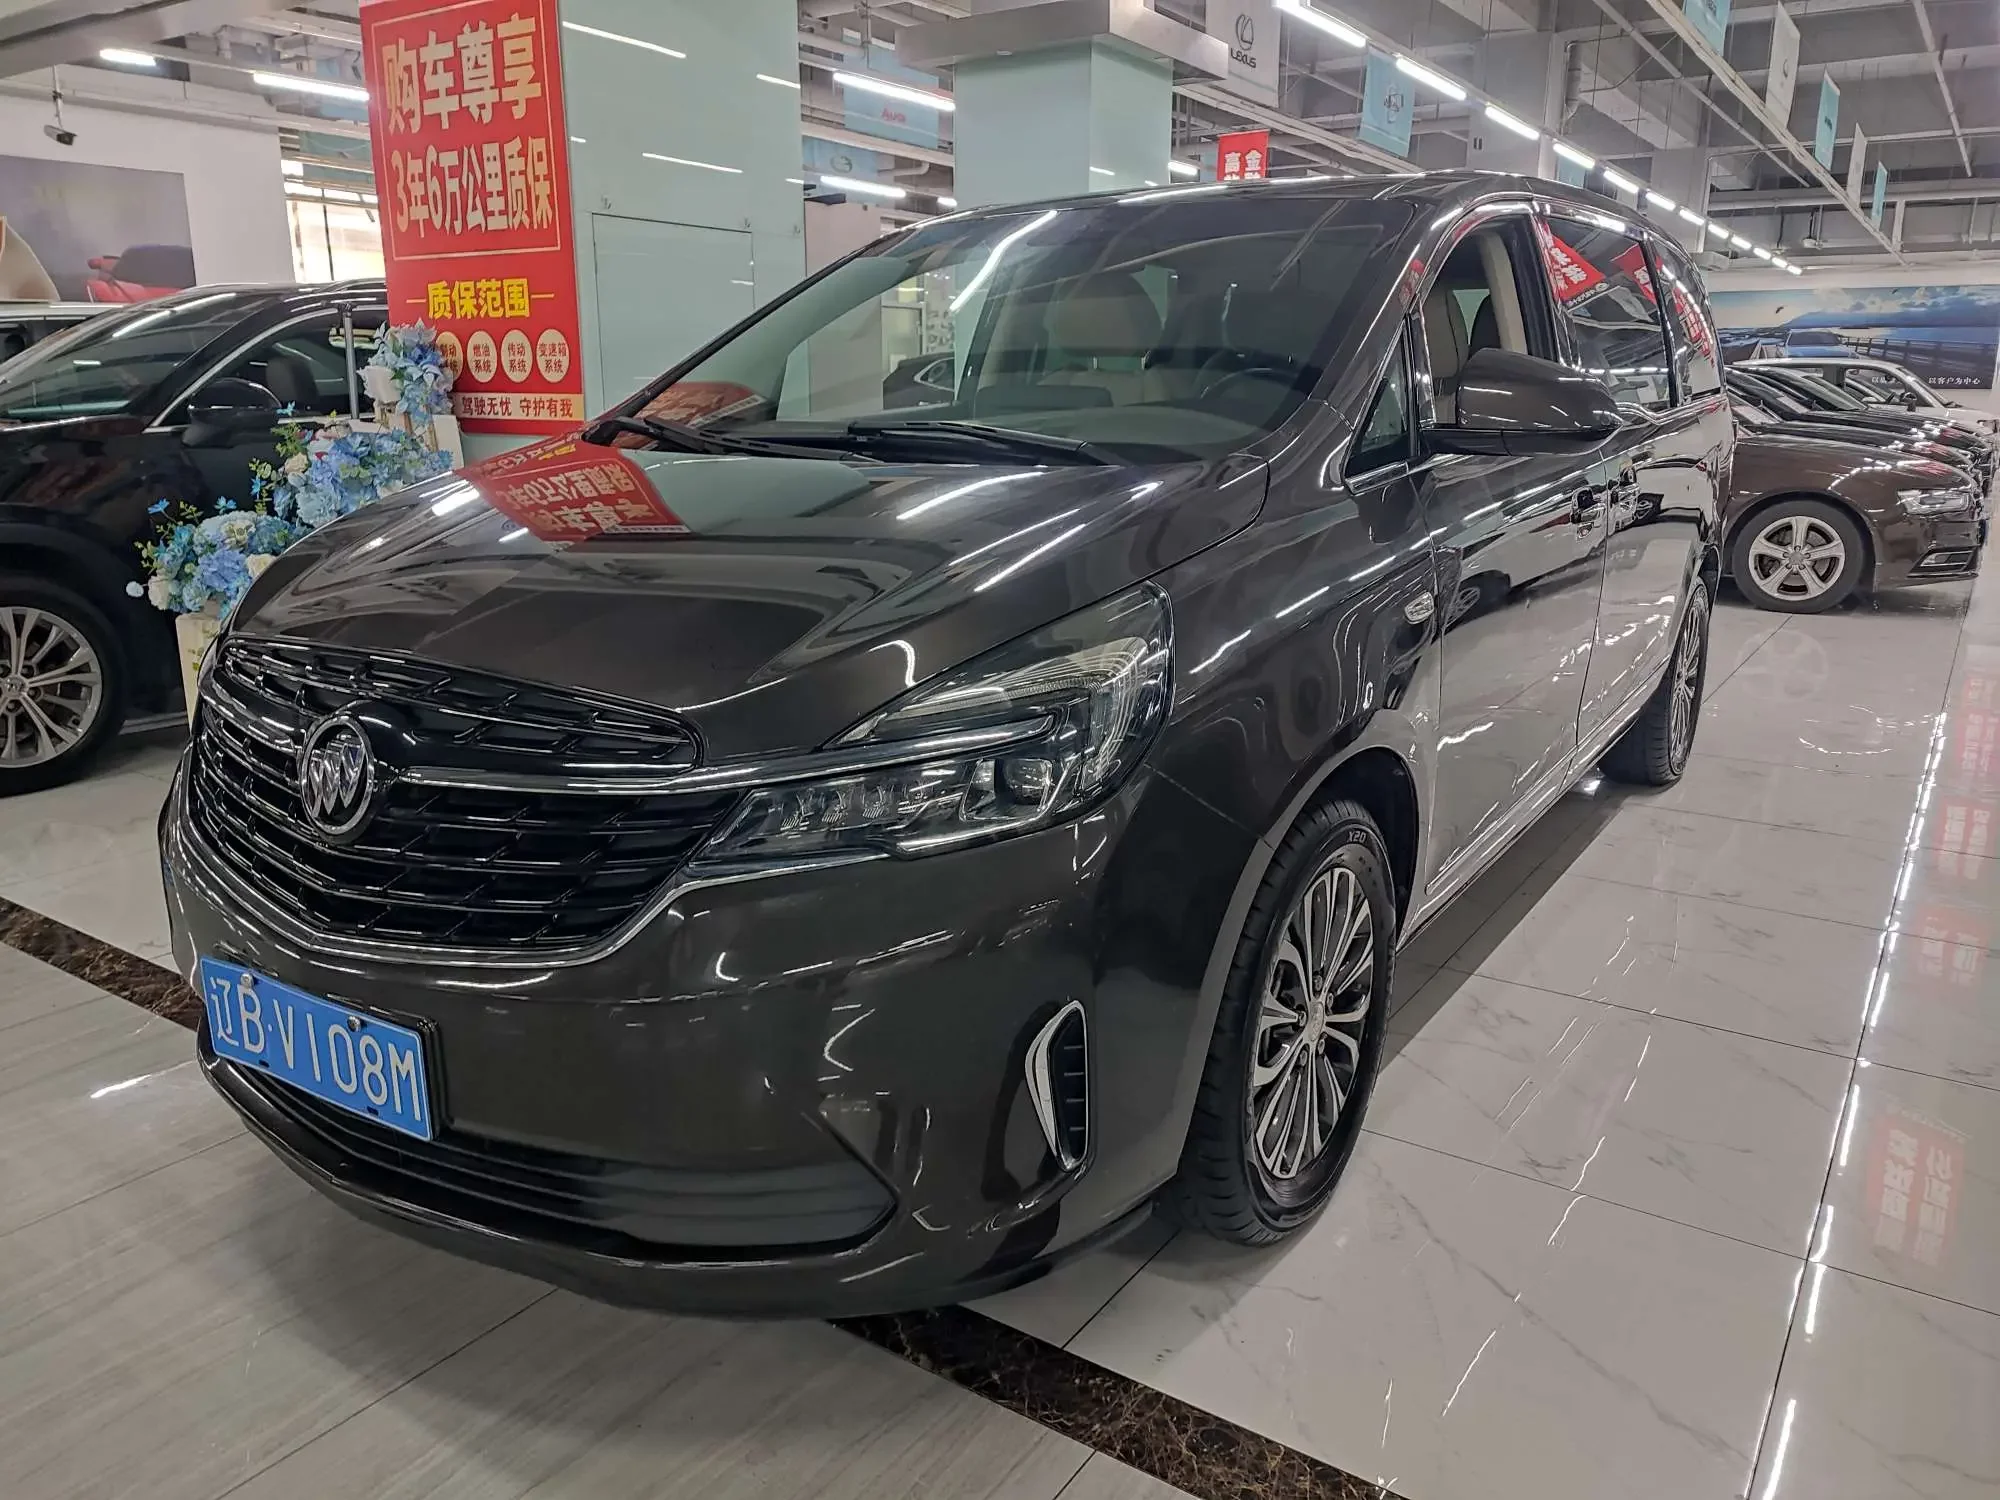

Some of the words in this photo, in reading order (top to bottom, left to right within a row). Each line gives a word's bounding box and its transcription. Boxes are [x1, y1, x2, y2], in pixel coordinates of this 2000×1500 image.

[382, 12, 541, 134] 购车尊享
[391, 136, 553, 239] 3年6万公里质保
[427, 278, 530, 319] 质保范围
[474, 359, 492, 373] 系统
[509, 359, 527, 373] 系统
[544, 359, 564, 374] 系统
[462, 397, 512, 416] 驾驶无忧
[520, 398, 573, 418] 守护有我
[210, 977, 422, 1121] 辽B·V108M
